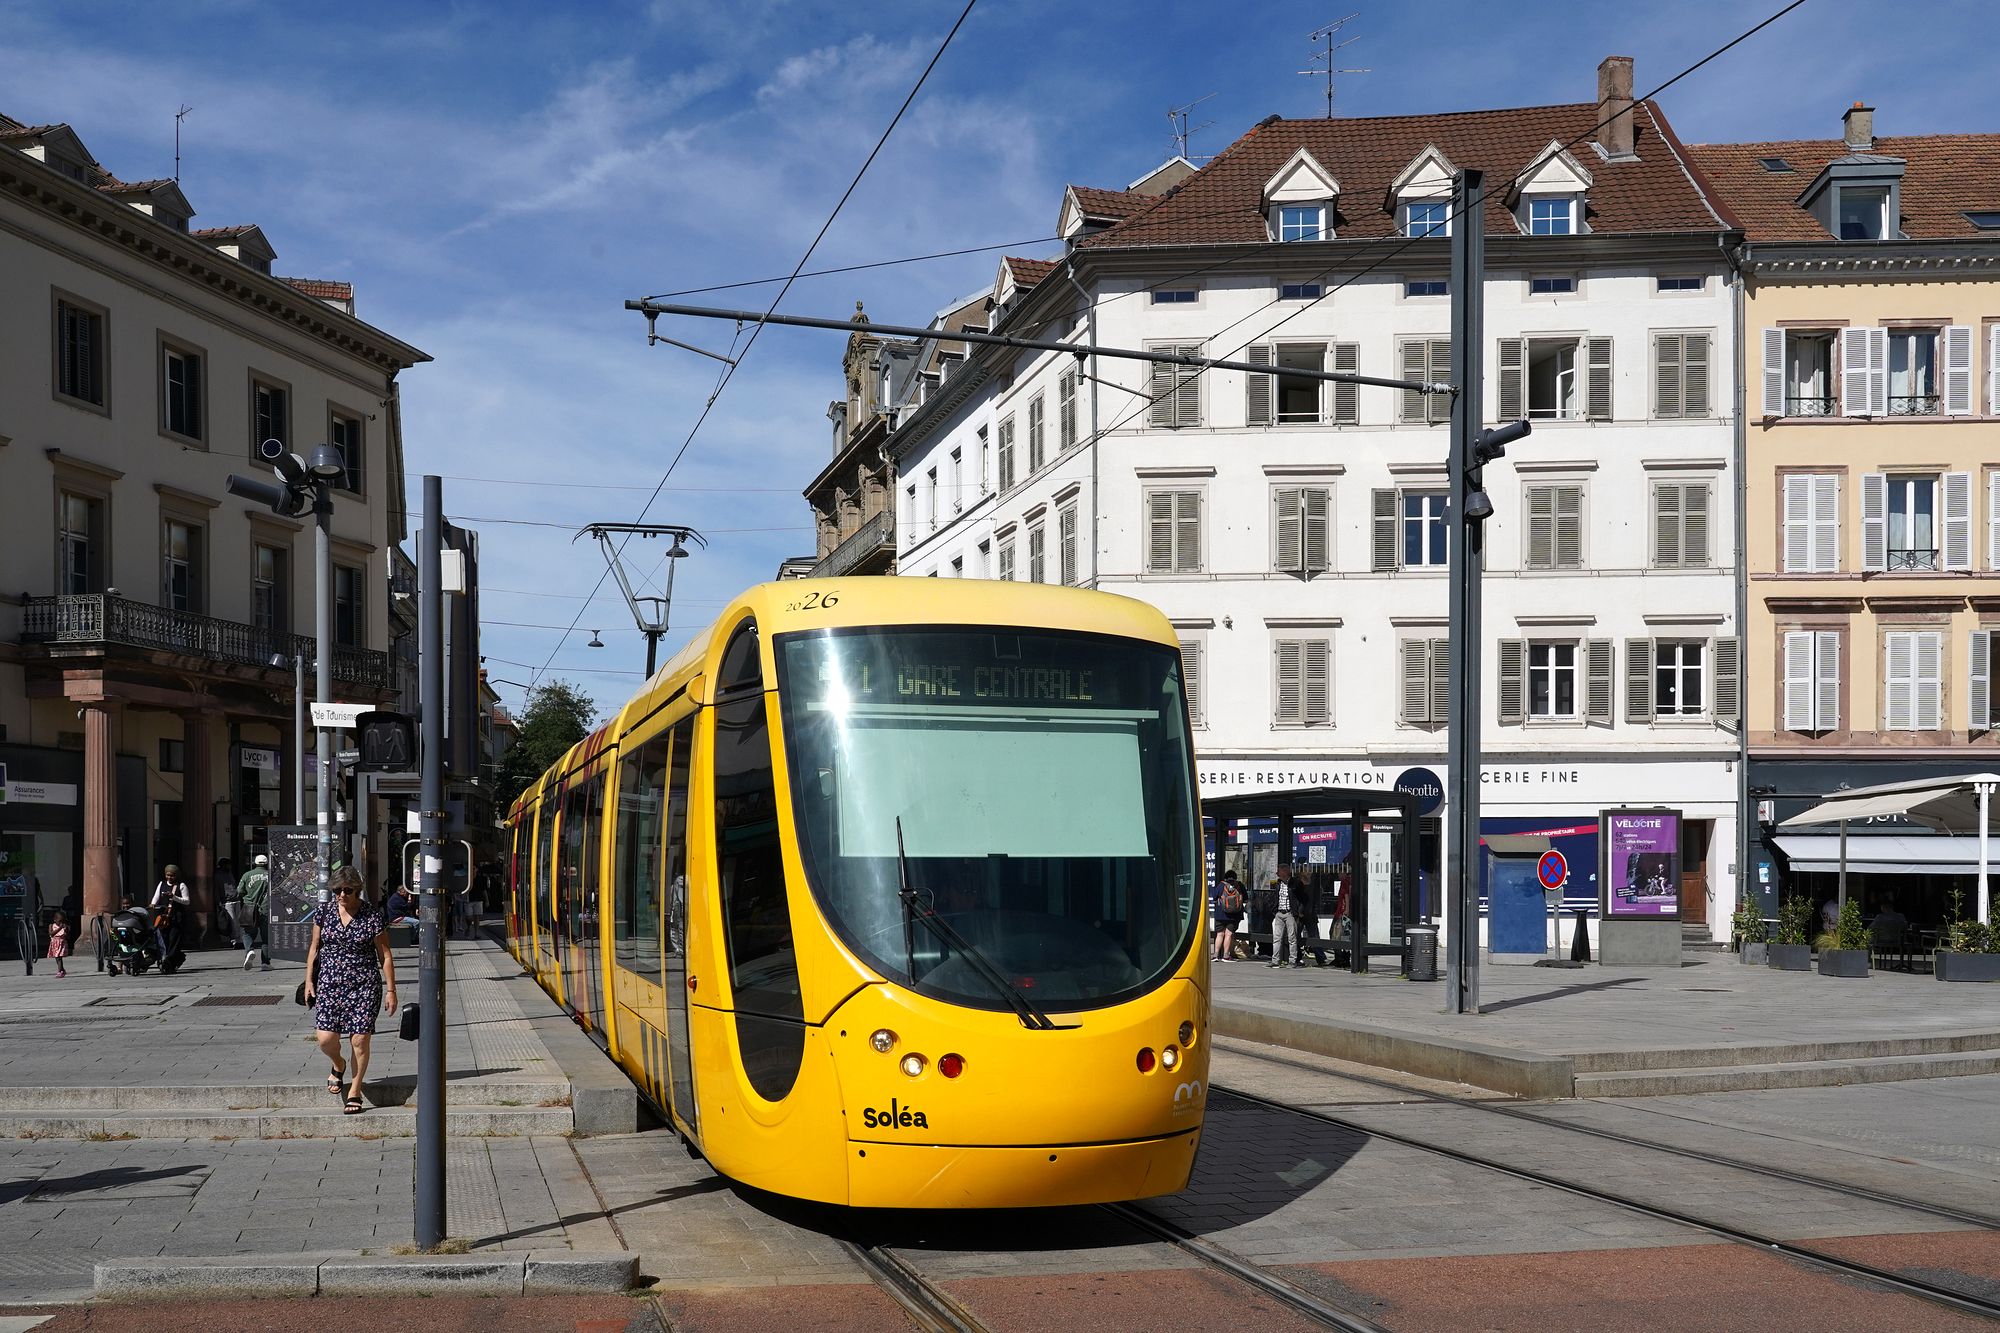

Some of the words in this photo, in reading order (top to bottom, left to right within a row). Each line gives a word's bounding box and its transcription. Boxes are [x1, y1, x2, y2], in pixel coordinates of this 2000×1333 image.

[785, 590, 841, 612] 2026
[898, 664, 961, 696] GARE
[974, 665, 1093, 701] CENTRALE
[326, 709, 357, 722] Tourisme
[1256, 772, 1385, 784] RESTAURATION
[1480, 771, 1530, 783] CERIE
[1541, 771, 1578, 783] FINE
[14, 785, 45, 794] Assurances
[1398, 784, 1439, 797] biscotte
[863, 1097, 929, 1130] Soléa
